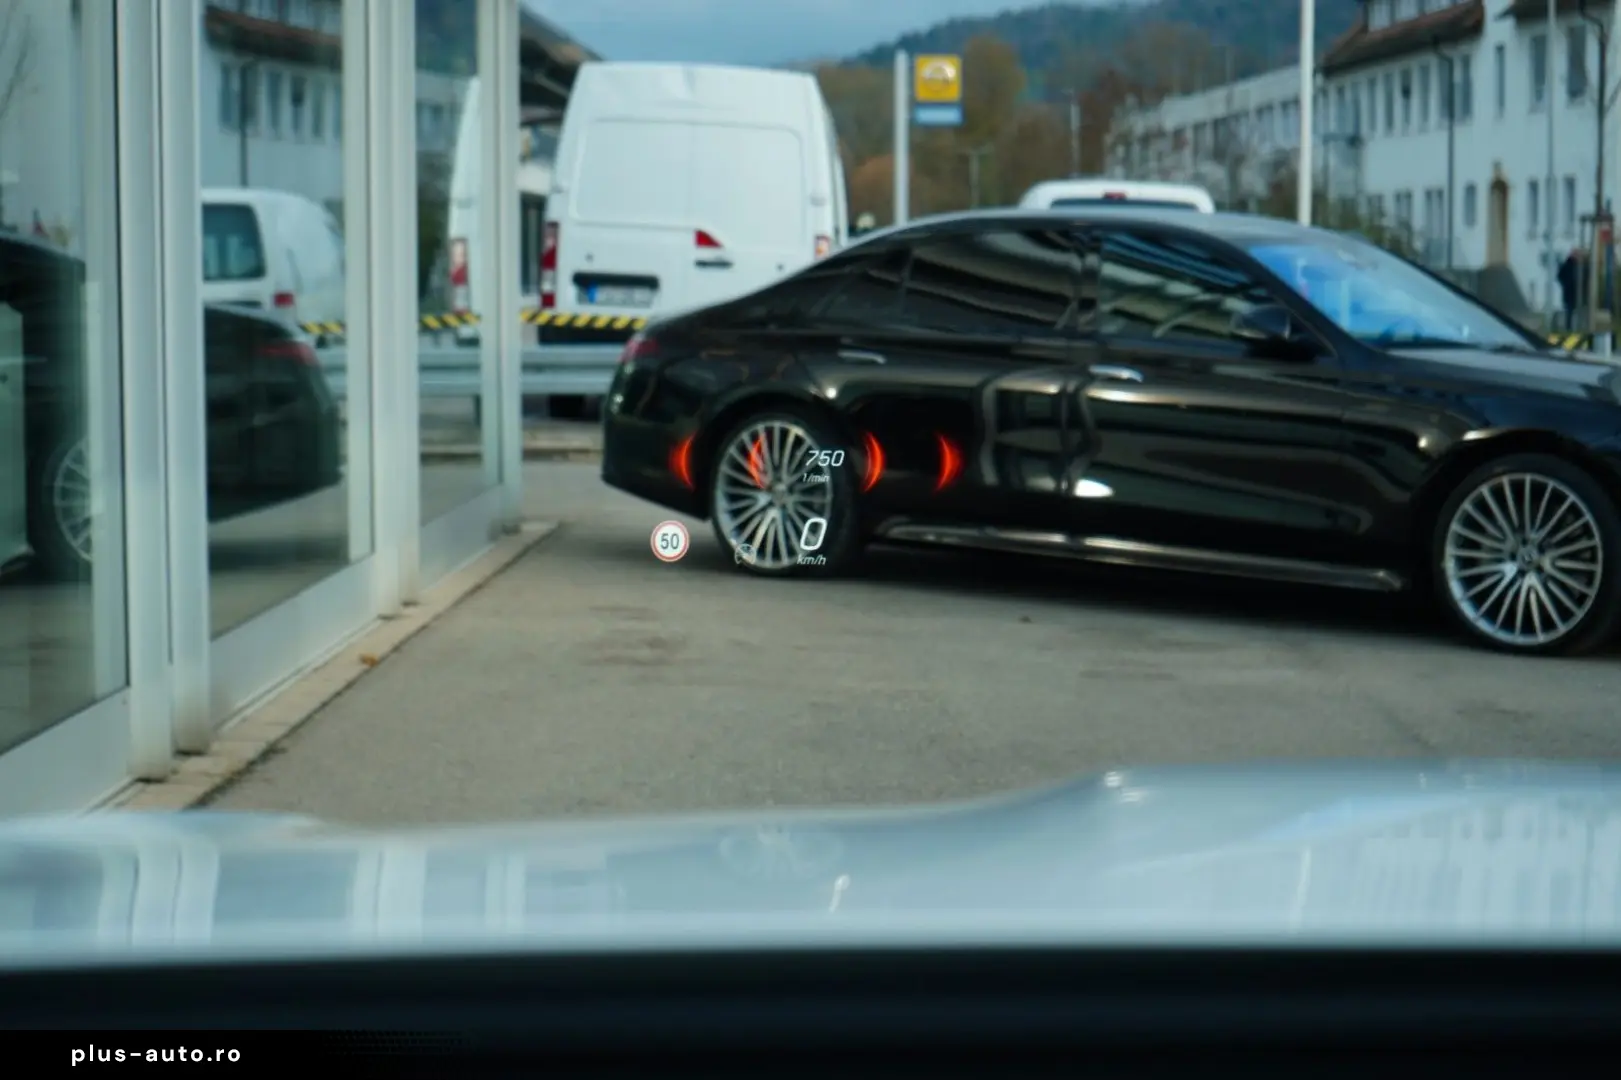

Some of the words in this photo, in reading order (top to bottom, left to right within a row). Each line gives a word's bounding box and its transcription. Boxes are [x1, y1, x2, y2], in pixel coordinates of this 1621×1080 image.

[805, 449, 845, 467] 750
[802, 473, 830, 483] 1/min
[660, 532, 680, 550] 50
[800, 517, 828, 551] 0
[797, 554, 827, 566] km/h
